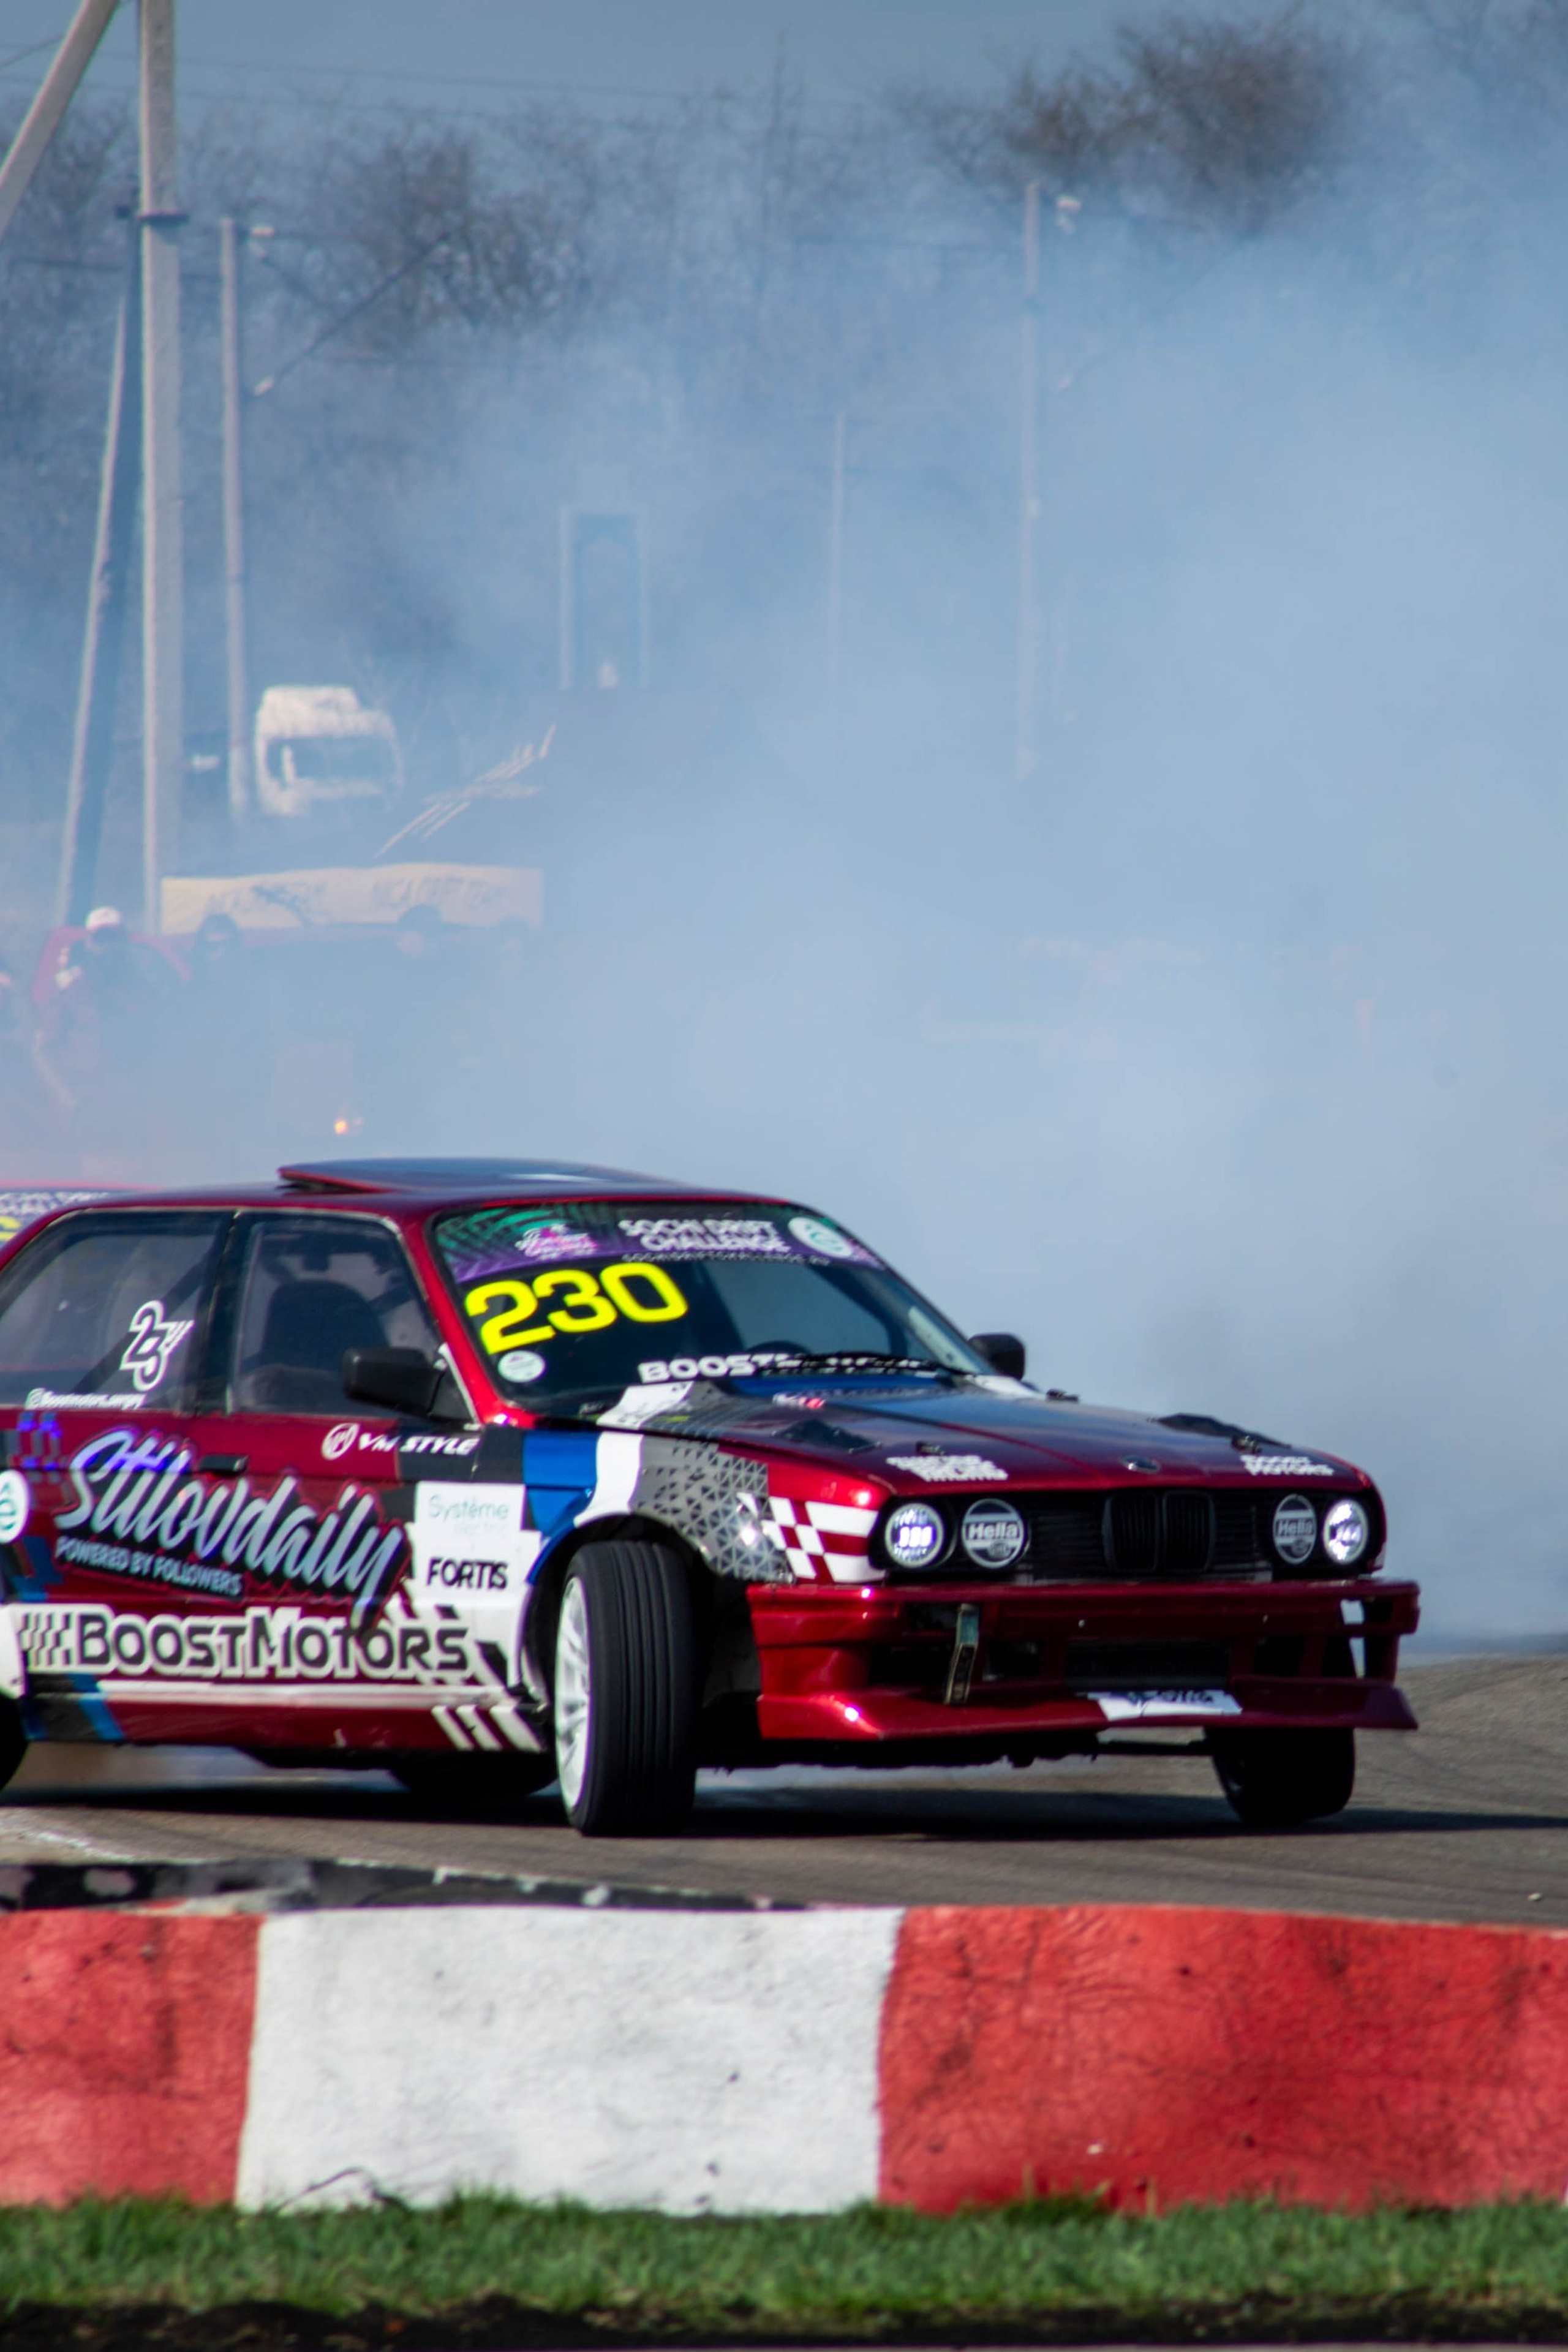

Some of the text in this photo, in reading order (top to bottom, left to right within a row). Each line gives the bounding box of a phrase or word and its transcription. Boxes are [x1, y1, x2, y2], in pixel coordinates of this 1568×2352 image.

[464, 1262, 688, 1354] 230
[359, 1432, 401, 1452] VM
[399, 1435, 481, 1455] STYLE
[968, 1521, 1017, 1539] Hella
[1278, 1518, 1313, 1536] Hella
[55, 1536, 243, 1596] POWERED BY FOLLOWERS
[426, 1557, 508, 1589] FORTIS
